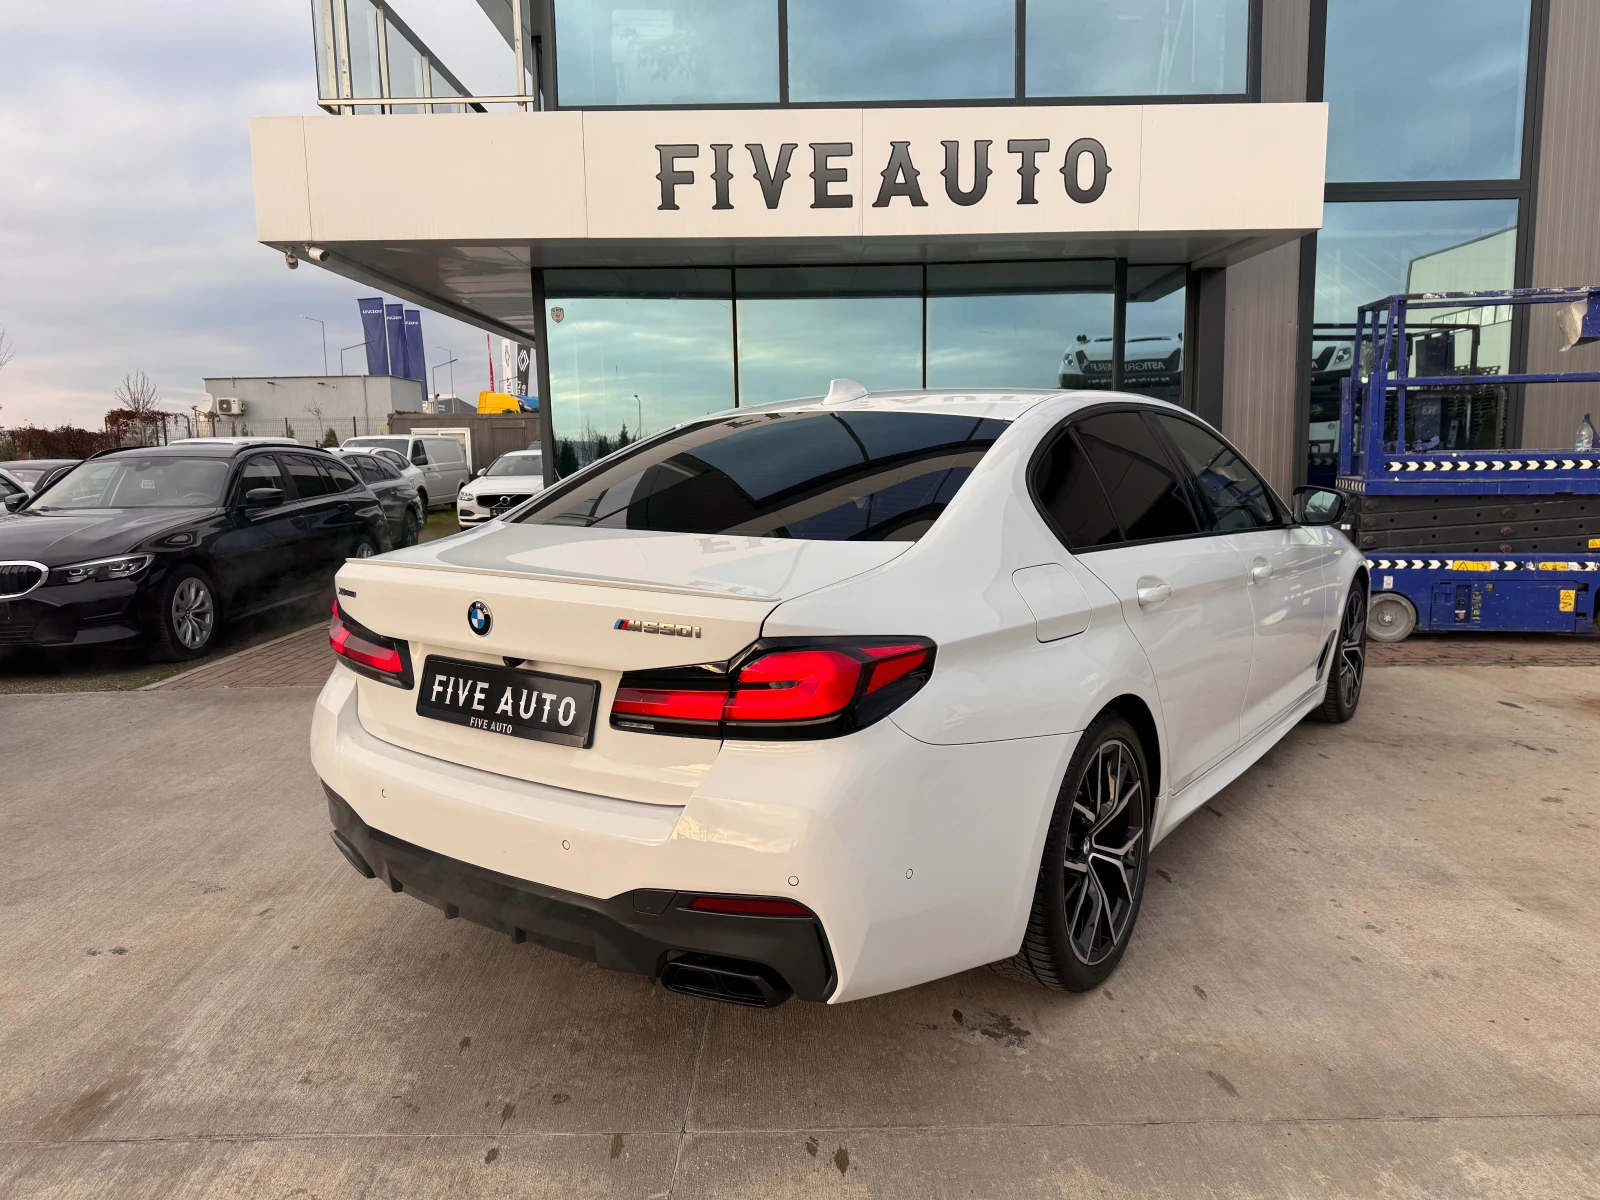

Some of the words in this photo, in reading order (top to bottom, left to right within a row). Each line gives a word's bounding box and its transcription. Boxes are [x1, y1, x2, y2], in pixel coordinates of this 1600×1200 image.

[626, 619, 701, 638] M550i
[430, 674, 489, 711] FIVE
[495, 686, 576, 727] AUTO
[470, 717, 488, 729] FIVE
[490, 723, 513, 734] AUTO
